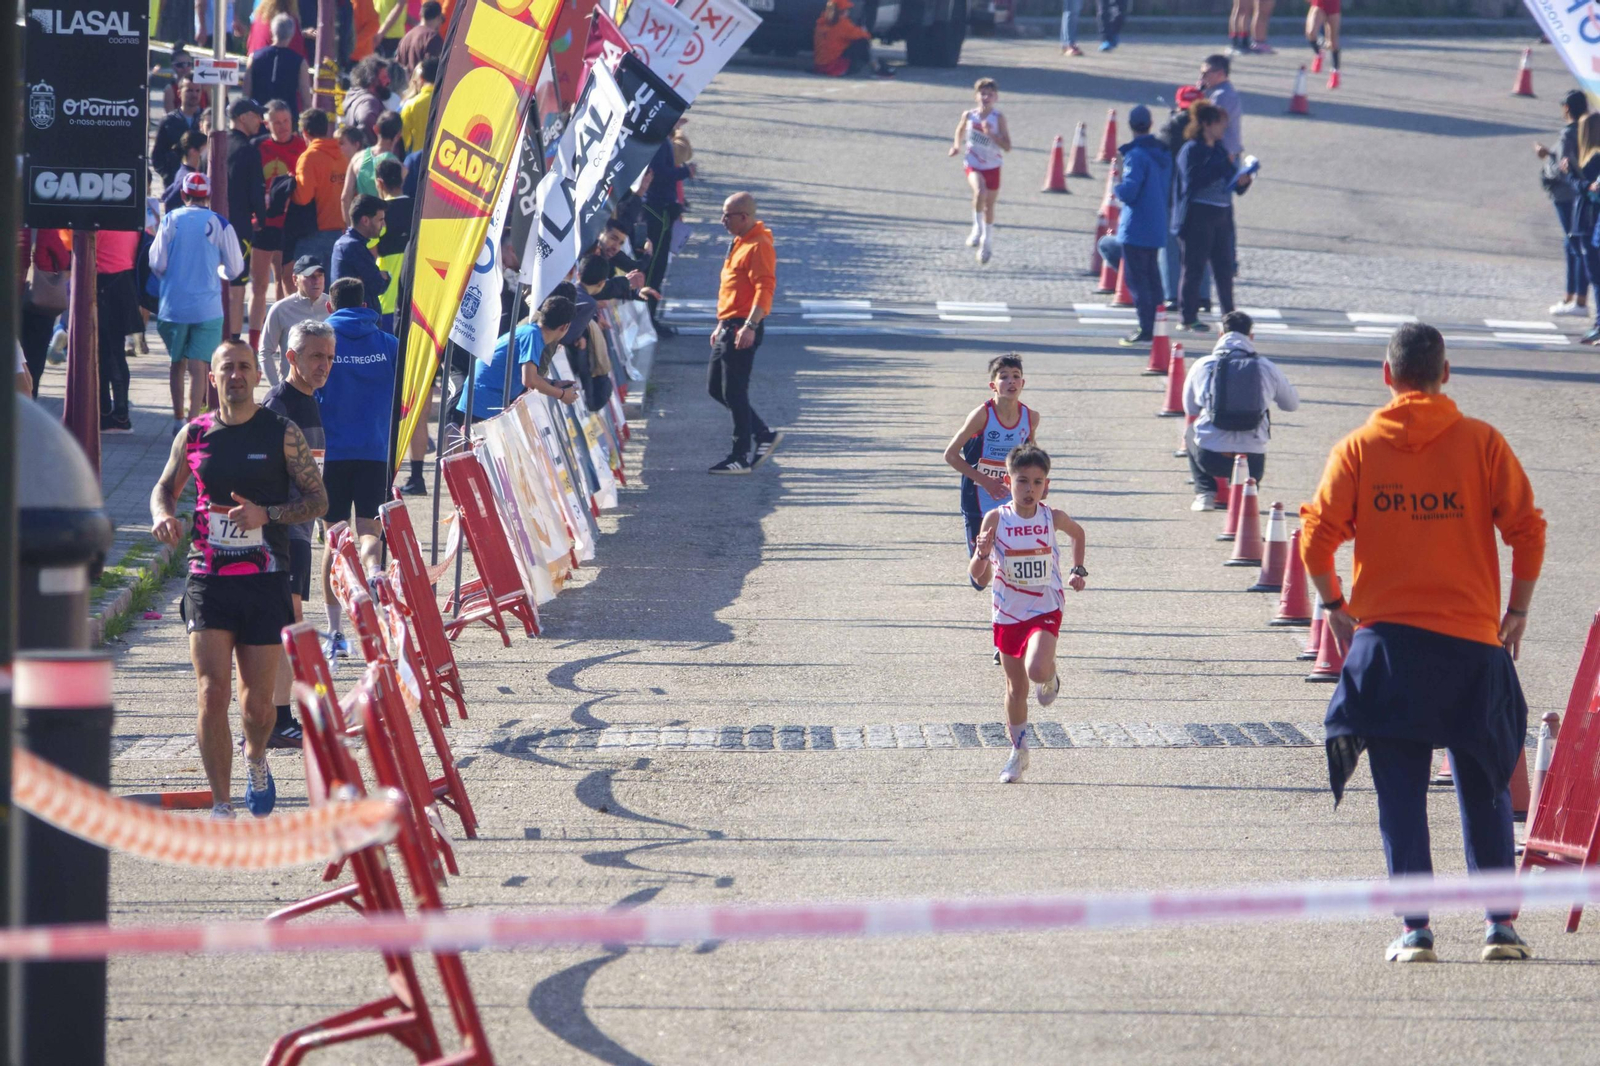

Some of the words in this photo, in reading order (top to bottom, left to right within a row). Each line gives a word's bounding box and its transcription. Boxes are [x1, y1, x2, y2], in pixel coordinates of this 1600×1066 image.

[56, 9, 140, 36] LASAL
[108, 36, 140, 45] cocinas
[220, 70, 234, 81] WC
[640, 100, 667, 134] DACIA
[437, 139, 499, 194] GADIS
[541, 103, 614, 243] LAAL
[34, 171, 132, 201] GADIS
[585, 160, 625, 224] ALPINE
[455, 316, 476, 333] oncello
[1013, 560, 1047, 579] 3091
